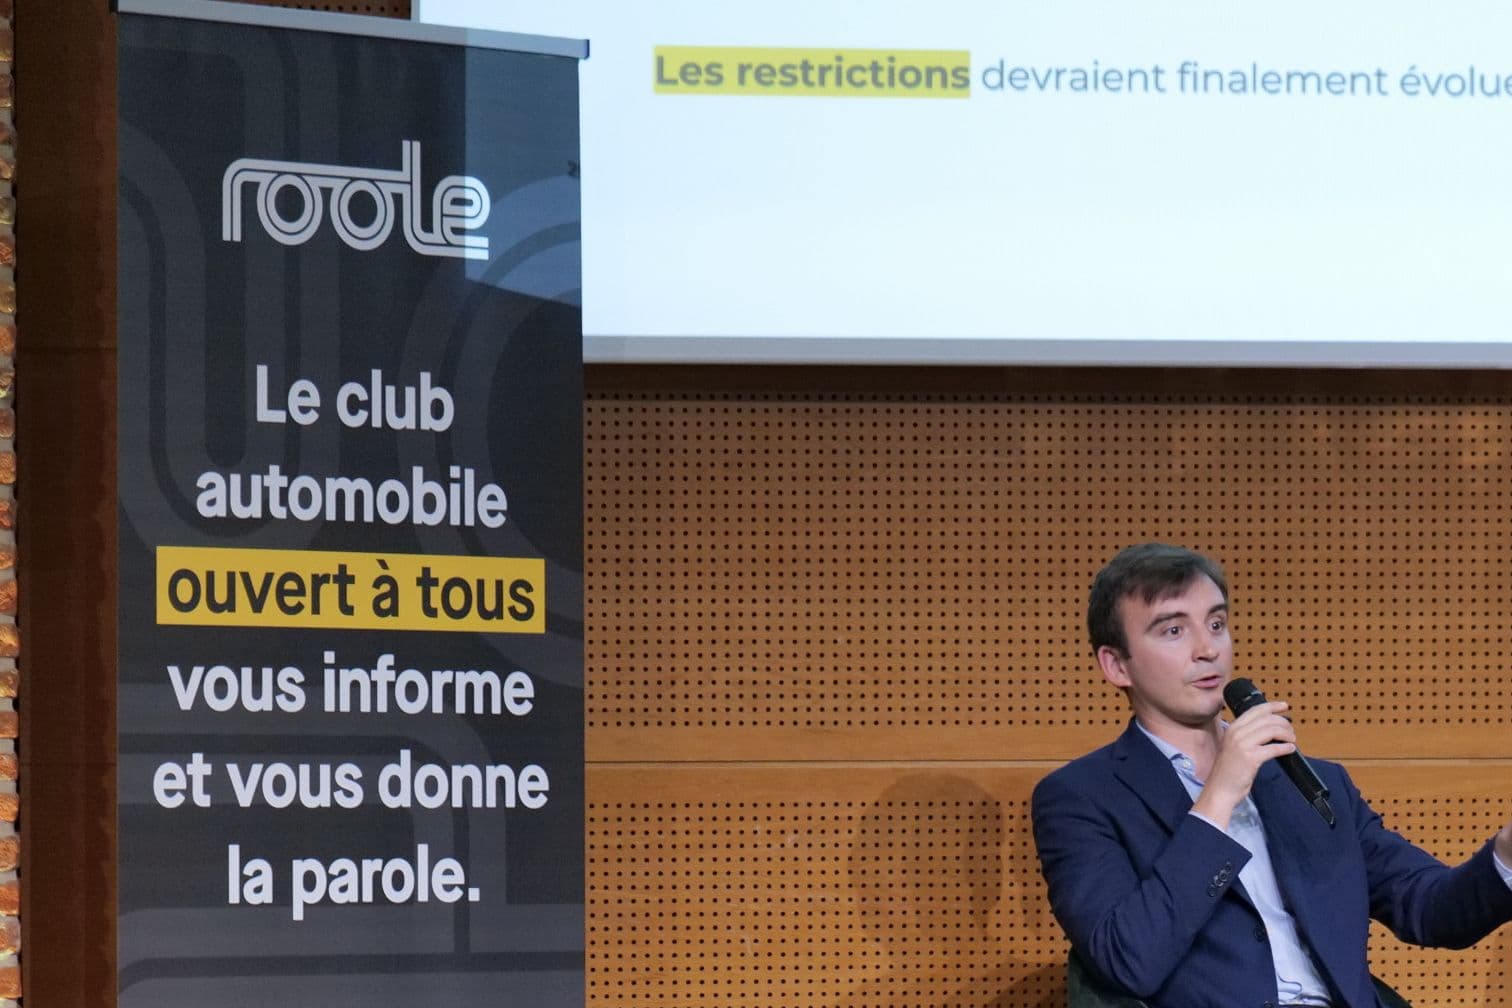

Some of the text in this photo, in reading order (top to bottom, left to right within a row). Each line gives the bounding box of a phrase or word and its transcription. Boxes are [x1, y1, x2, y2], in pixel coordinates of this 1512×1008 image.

[655, 54, 725, 88] Les
[737, 55, 971, 91] restrictions
[981, 58, 1167, 94] devraient
[1176, 60, 1389, 97] finalement
[222, 140, 491, 260] roole
[256, 364, 456, 433] Le club
[195, 464, 509, 530] automobile
[167, 559, 535, 622] ouvert à tous
[166, 651, 536, 717] vous informe
[152, 749, 551, 811] et vous donne
[227, 842, 482, 922] la parole.
